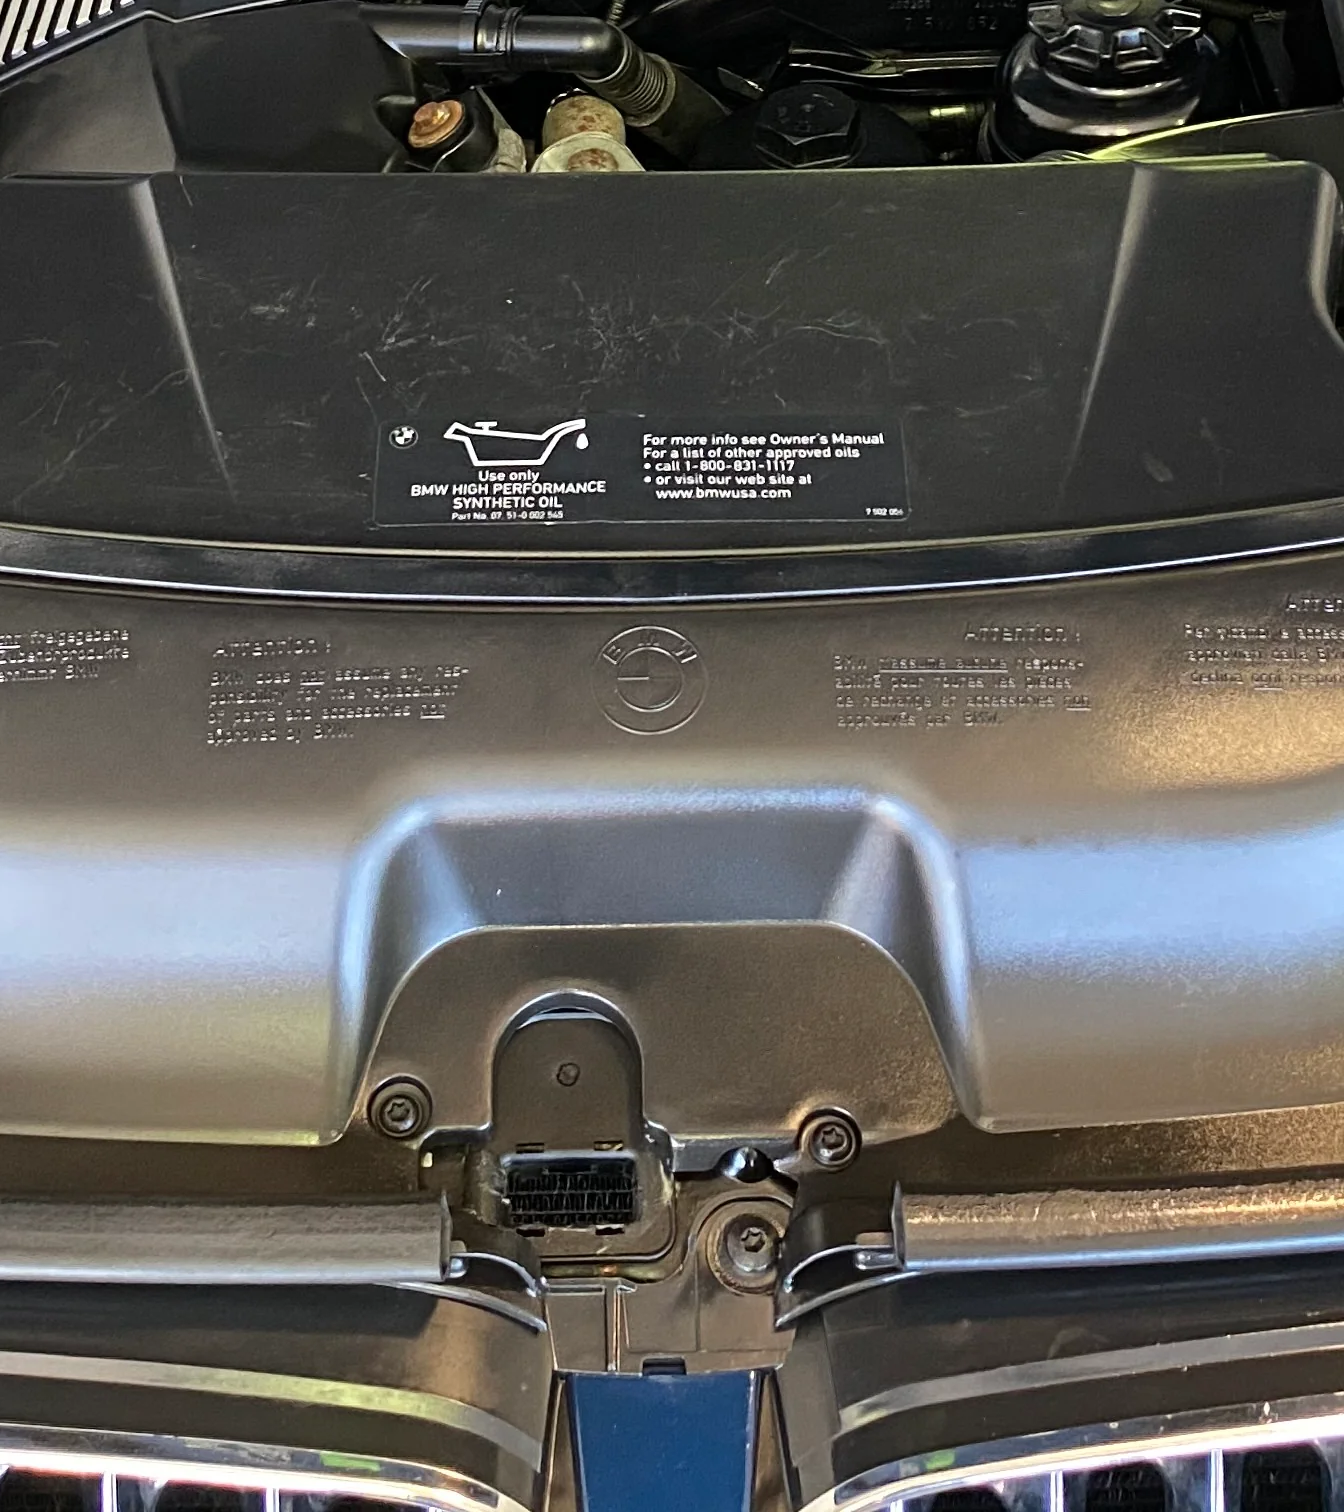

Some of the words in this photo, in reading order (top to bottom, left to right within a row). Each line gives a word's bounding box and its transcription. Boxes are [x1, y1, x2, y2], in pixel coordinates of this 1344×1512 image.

[643, 433, 666, 445] For
[670, 435, 707, 445] more
[711, 433, 738, 445] info
[741, 435, 766, 445] see
[769, 432, 828, 445] Owner's
[832, 432, 885, 445] Manual
[643, 447, 666, 459] For
[670, 449, 679, 459] a
[683, 446, 704, 459] list
[707, 446, 723, 458] of
[725, 446, 762, 458] other
[766, 446, 831, 462] approved
[835, 446, 861, 458] oils
[655, 460, 680, 472] call
[684, 459, 795, 472] 1-800-831-1117
[478, 470, 505, 482] Use
[510, 468, 540, 484] only
[655, 475, 671, 485] or
[674, 474, 704, 485] visit
[707, 475, 731, 485] our
[735, 473, 765, 485] web
[769, 473, 795, 485] site
[799, 473, 812, 485] at
[411, 484, 449, 497] BMW
[453, 483, 489, 496] HIGH
[493, 480, 606, 496] PERFORMANCE
[655, 488, 792, 499] www.bmwusa.com
[453, 496, 535, 510] SYNTHETIC
[539, 495, 563, 508] OIL
[452, 511, 471, 520] Part
